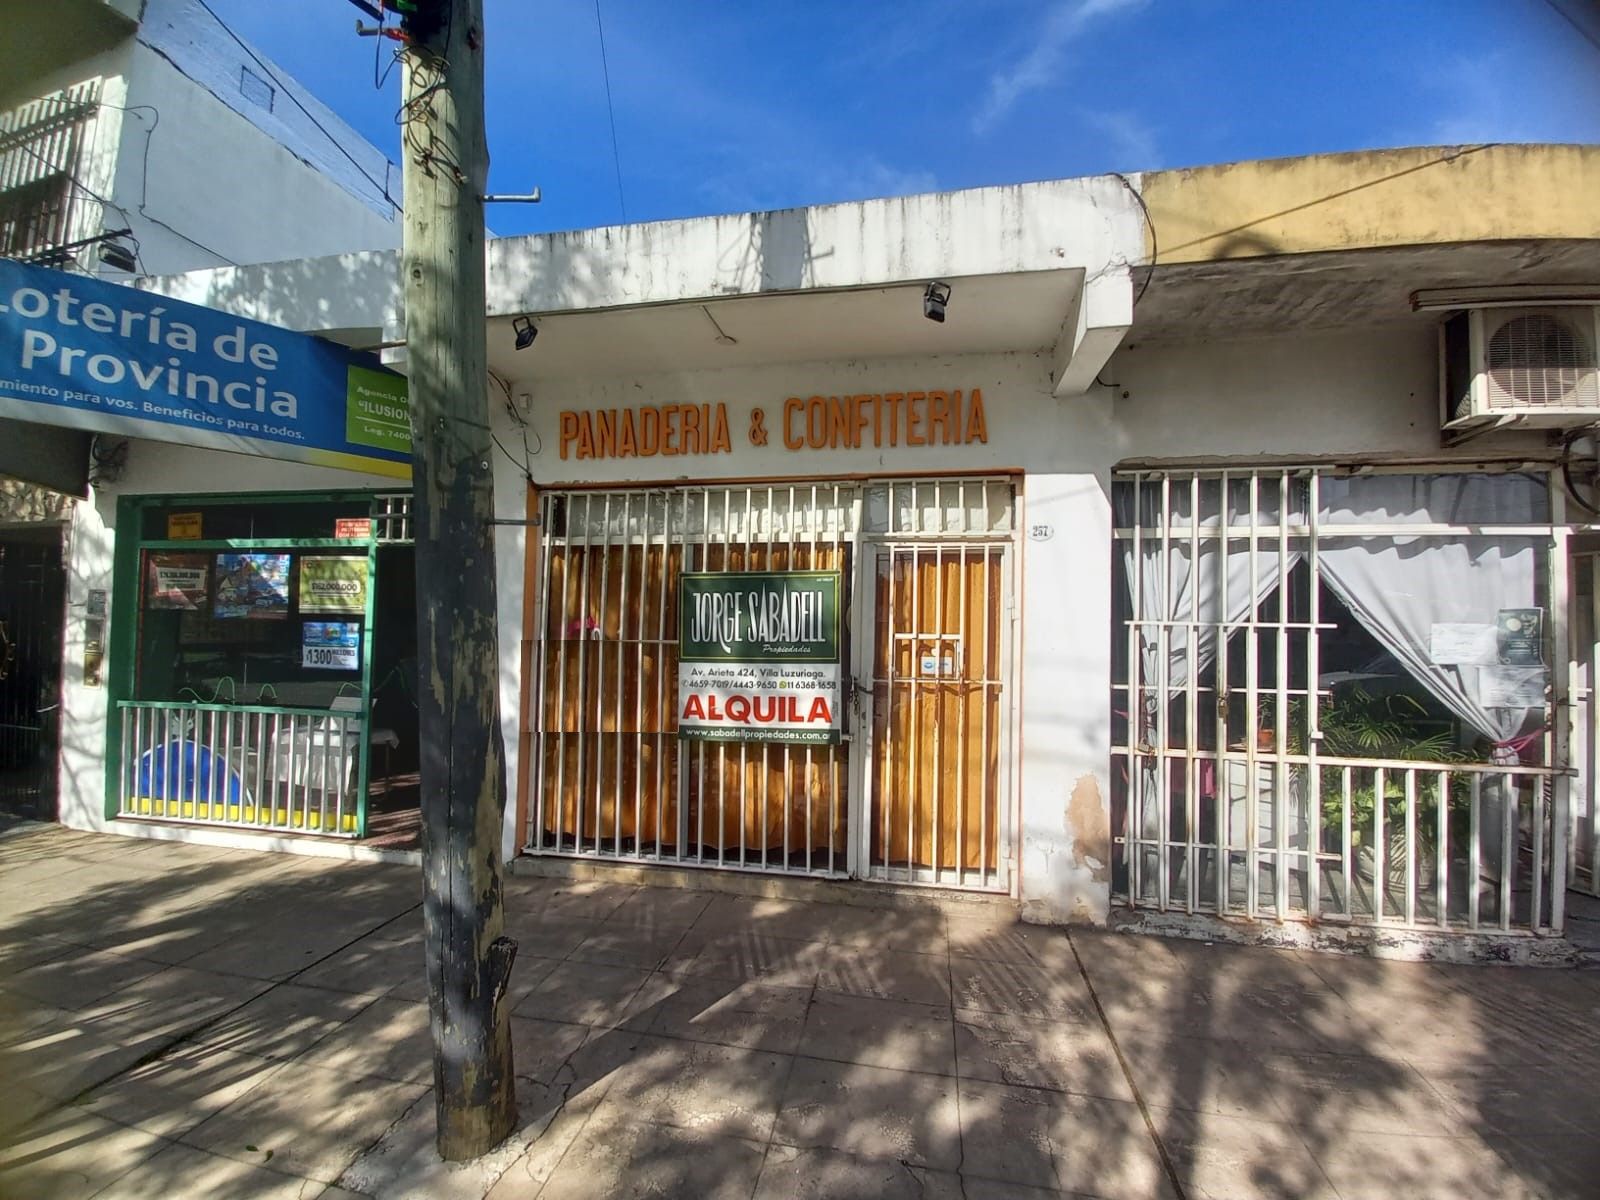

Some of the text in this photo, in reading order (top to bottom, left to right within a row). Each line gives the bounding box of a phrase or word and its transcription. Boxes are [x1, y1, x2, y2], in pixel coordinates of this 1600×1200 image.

[0, 287, 279, 371] otería de
[21, 330, 298, 420] Provincia
[357, 386, 397, 402] Agencia
[63, 389, 101, 404] para
[105, 396, 139, 410] vos.
[143, 401, 223, 425] Beneficios
[227, 418, 259, 432] para
[263, 423, 305, 440] todos.
[559, 388, 988, 460] PANADERIA & CONFITERIA
[1032, 525, 1049, 537] 257
[691, 582, 826, 654] JORGE SABADELL
[762, 643, 812, 654] Propiedades
[690, 668, 827, 680] Av. Arieta 424, Villa Luzuriaga.
[682, 694, 833, 725] ALQUILA
[686, 728, 831, 740] www.sabadellpropiedades.com.ar
